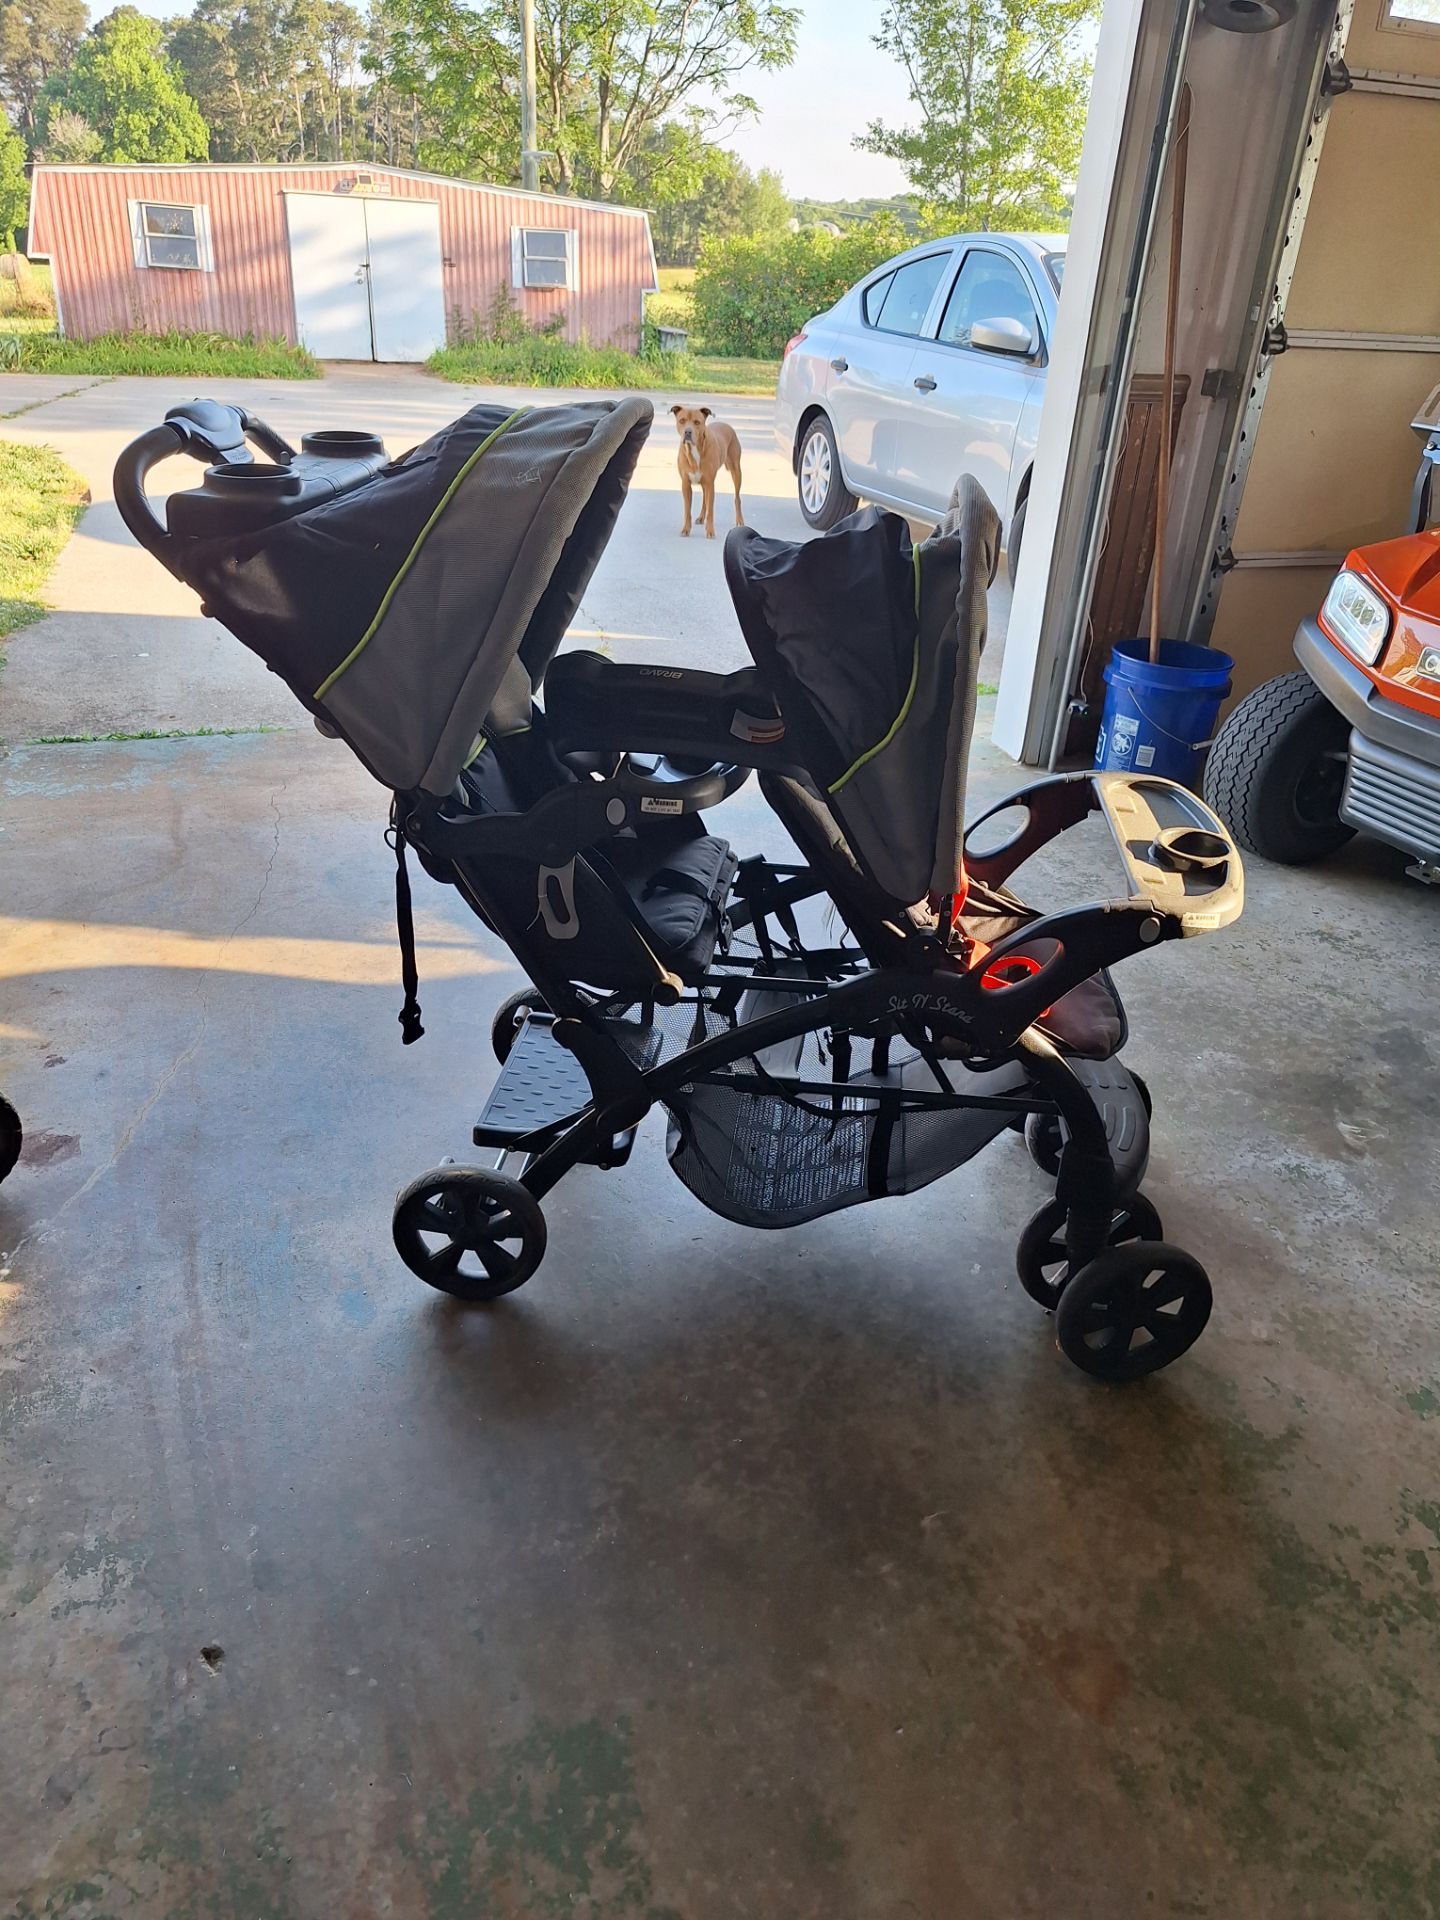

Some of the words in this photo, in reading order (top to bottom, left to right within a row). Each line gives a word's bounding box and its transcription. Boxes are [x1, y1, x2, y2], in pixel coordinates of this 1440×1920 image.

[639, 668, 684, 679] BRAVO
[886, 995, 908, 1013] Sit
[929, 996, 975, 1024] Stand
